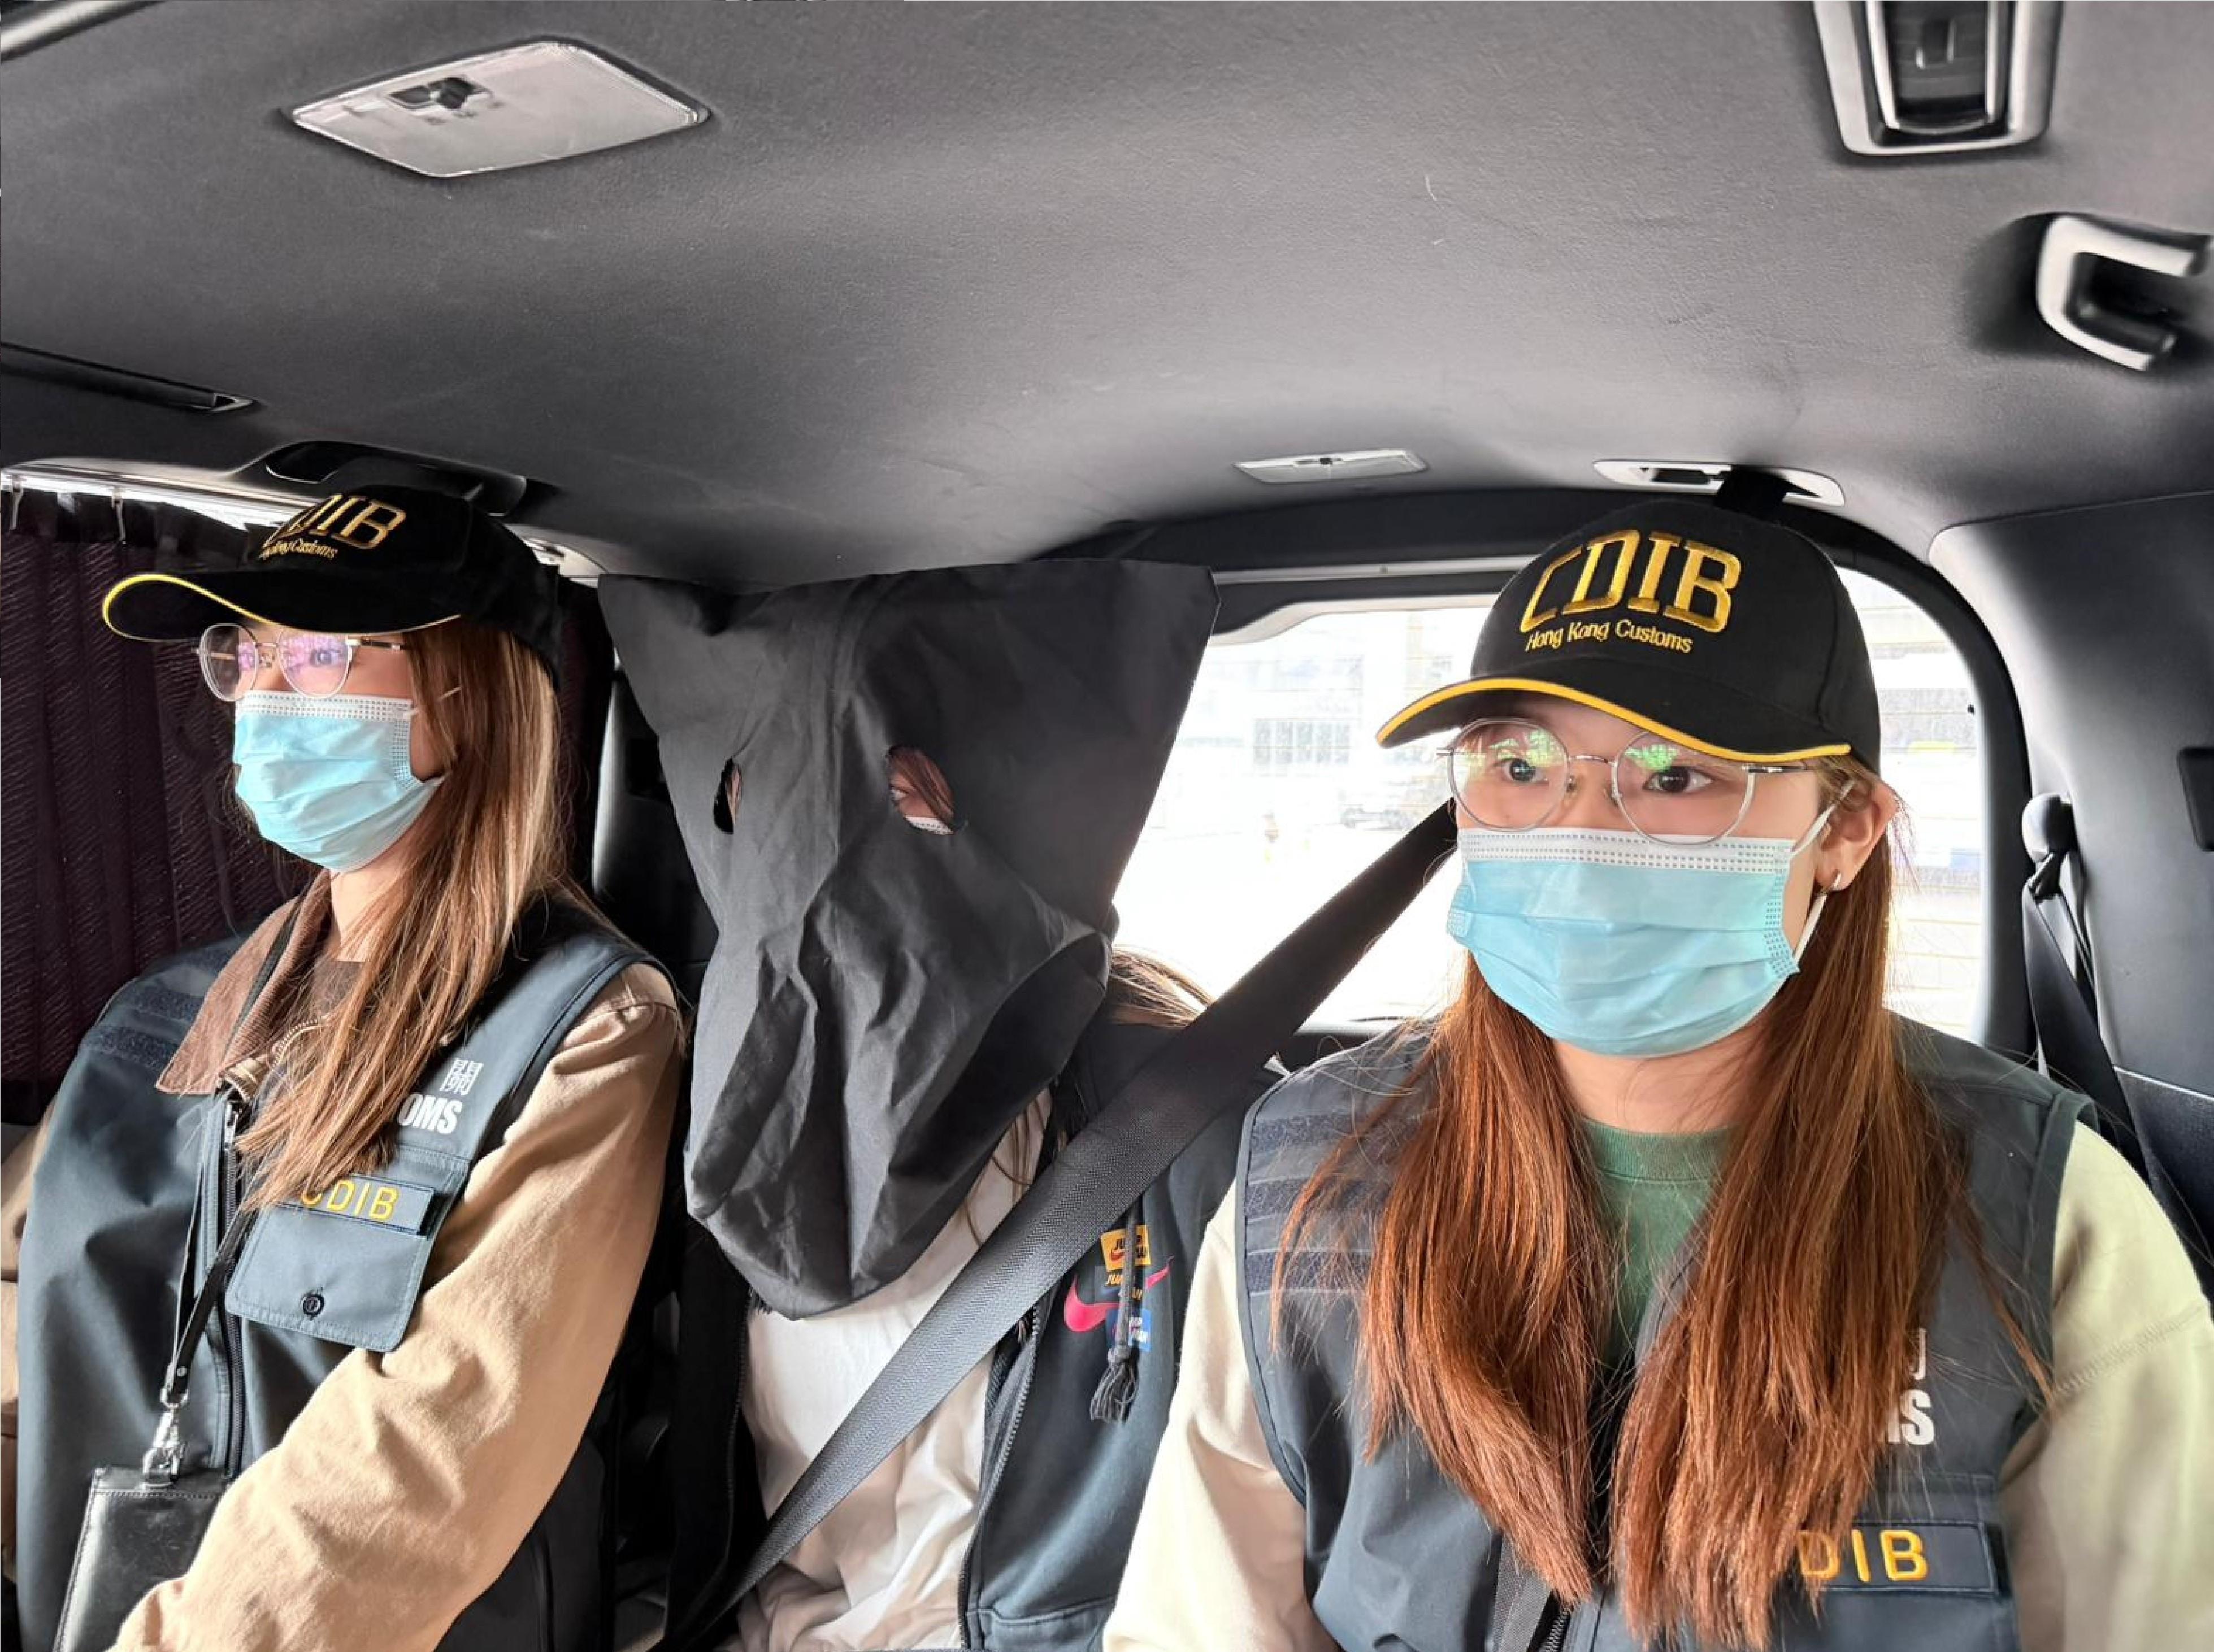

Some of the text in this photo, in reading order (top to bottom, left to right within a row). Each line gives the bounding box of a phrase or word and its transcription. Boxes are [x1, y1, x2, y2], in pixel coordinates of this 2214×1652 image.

[1520, 529, 1742, 633] CDIB
[1524, 619, 1694, 654] Hong Kong Customs
